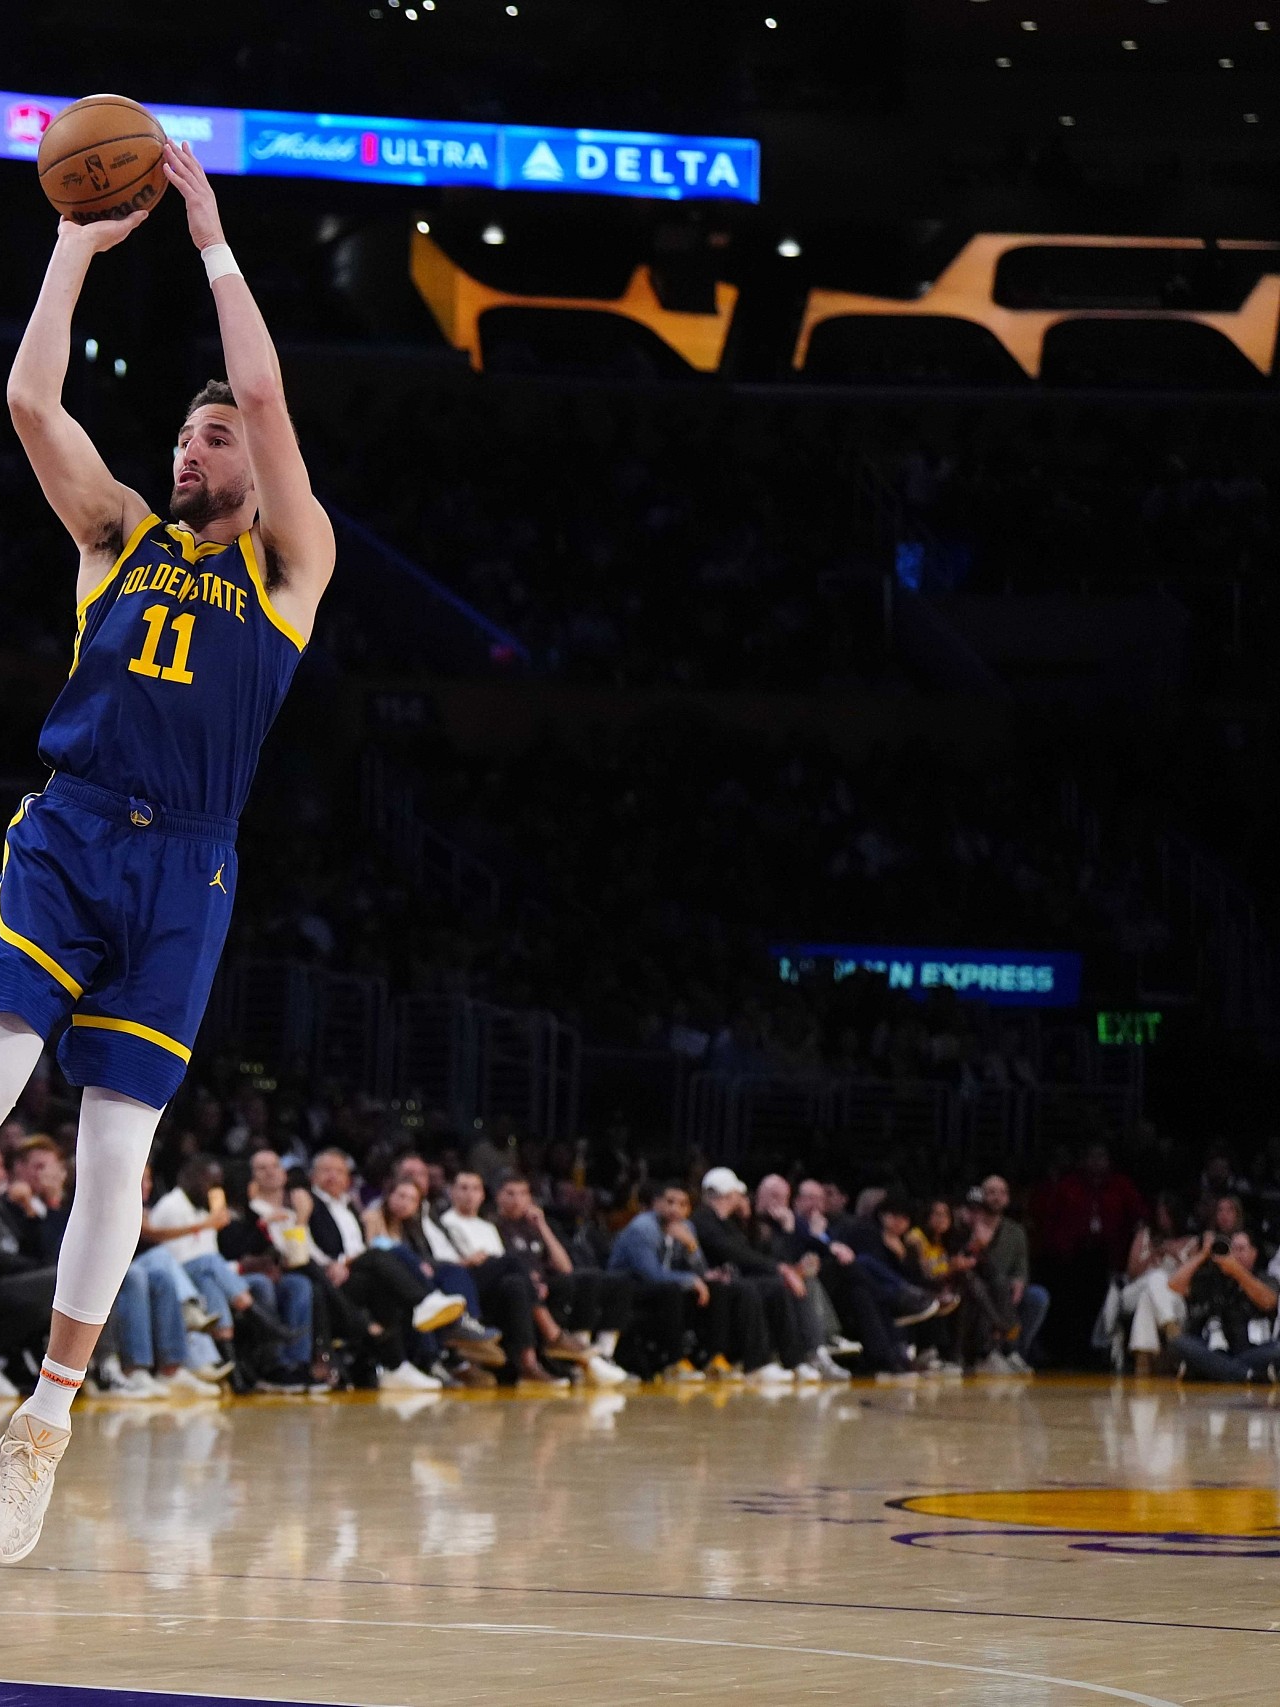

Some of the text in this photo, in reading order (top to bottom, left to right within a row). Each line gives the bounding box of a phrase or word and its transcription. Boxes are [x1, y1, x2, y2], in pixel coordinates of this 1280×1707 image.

[381, 137, 489, 170] ULTRA
[575, 144, 740, 189] DELTA
[127, 603, 197, 685] 11
[920, 961, 1055, 993] EXPRESS
[1097, 1011, 1162, 1045] EXIT
